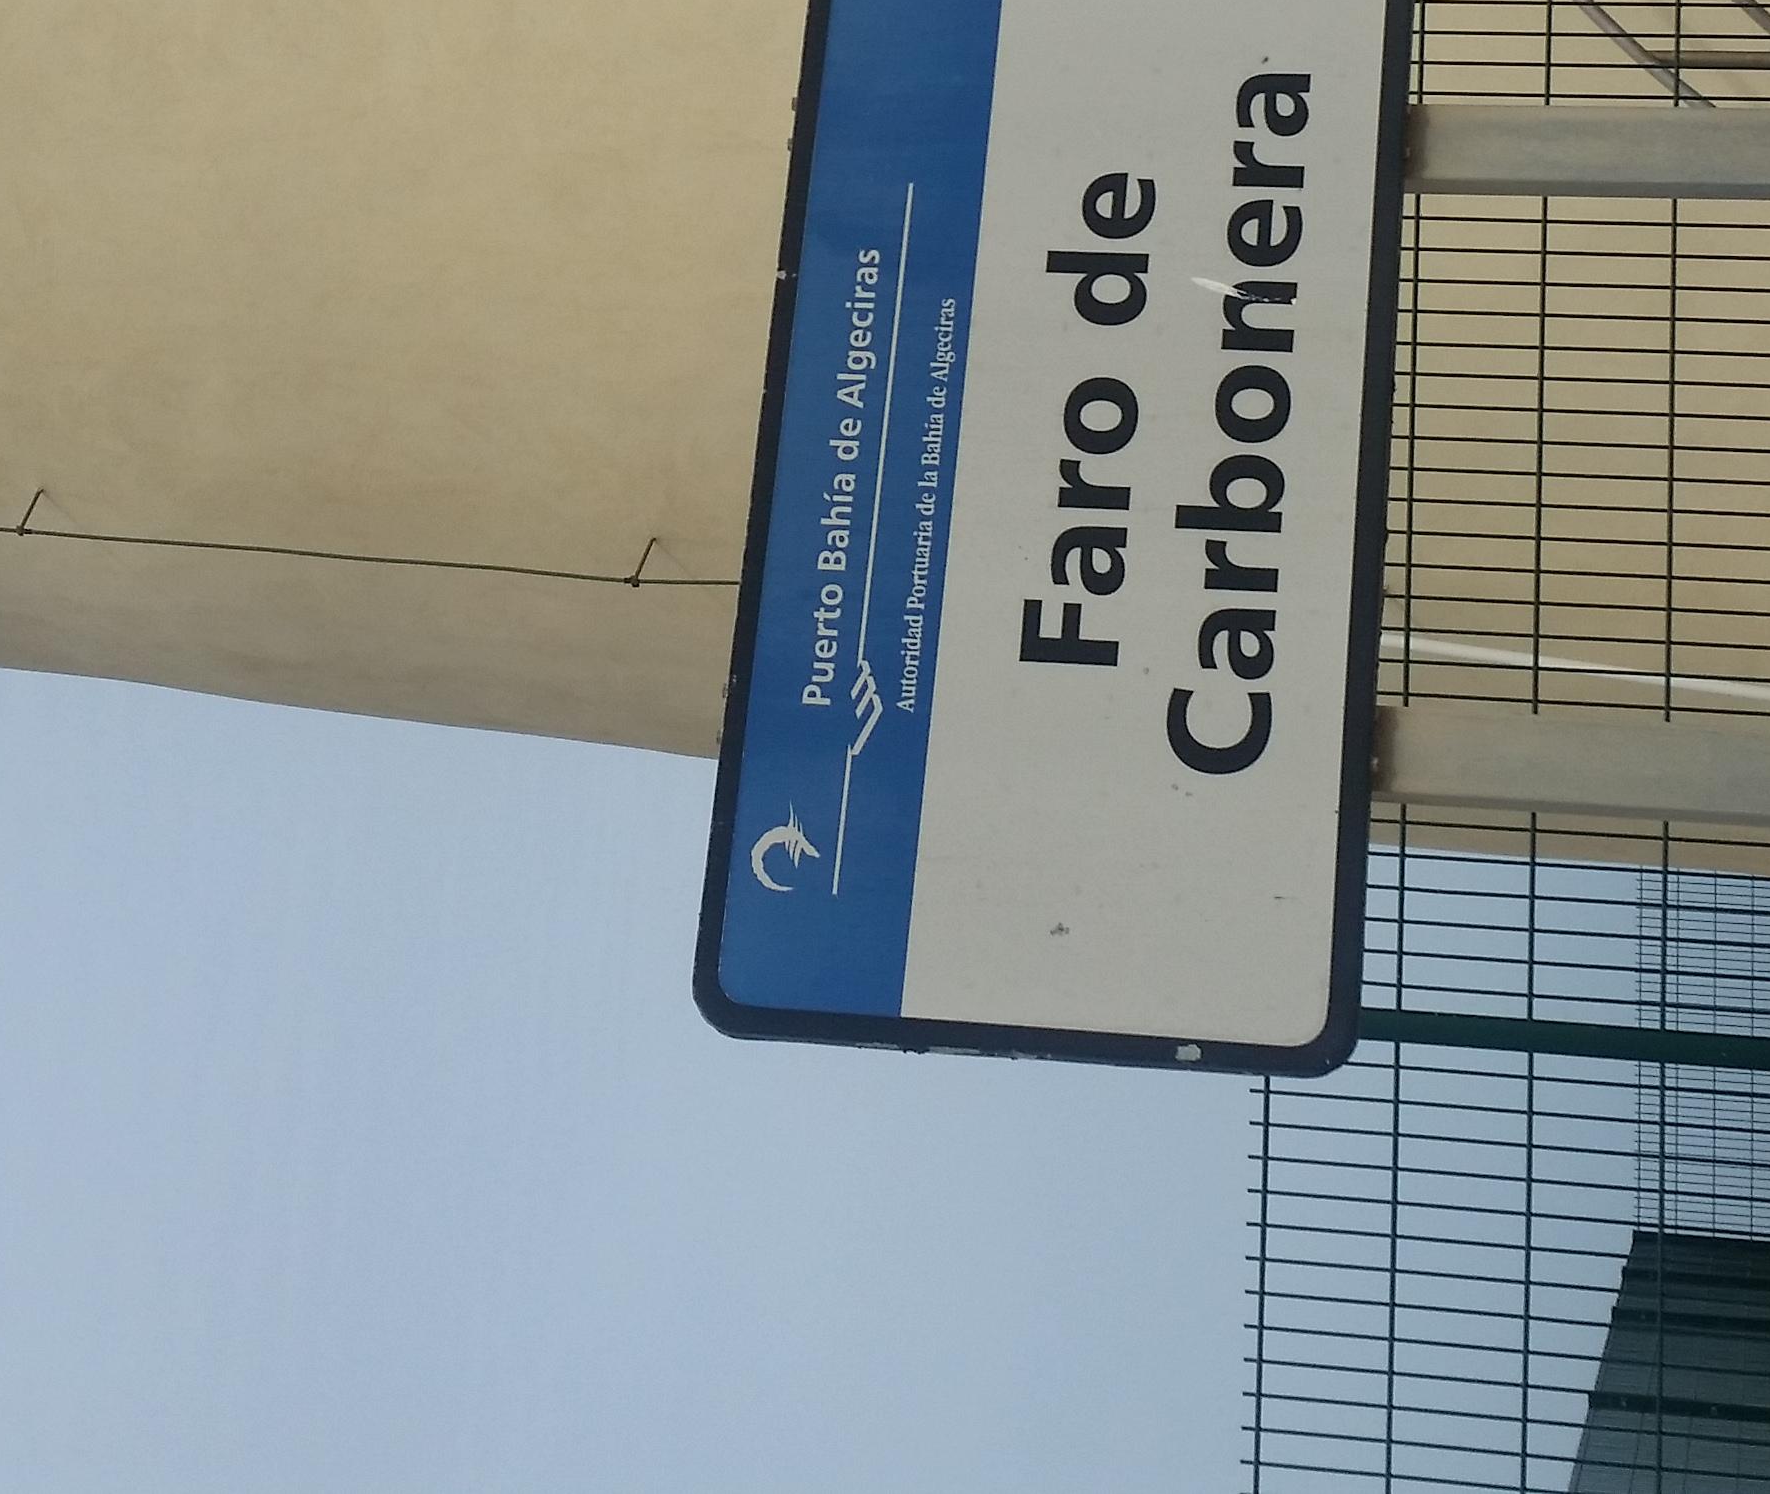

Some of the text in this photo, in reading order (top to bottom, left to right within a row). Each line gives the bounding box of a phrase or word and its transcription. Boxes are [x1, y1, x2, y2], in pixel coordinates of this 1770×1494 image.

[802, 248, 880, 706] Puerto Bahía de Algeciras
[896, 296, 956, 713] Autoridad Portuaria de la Bahía de Algeciras
[1018, 171, 1157, 667] Faro de
[1166, 72, 1312, 775] Carbonera
